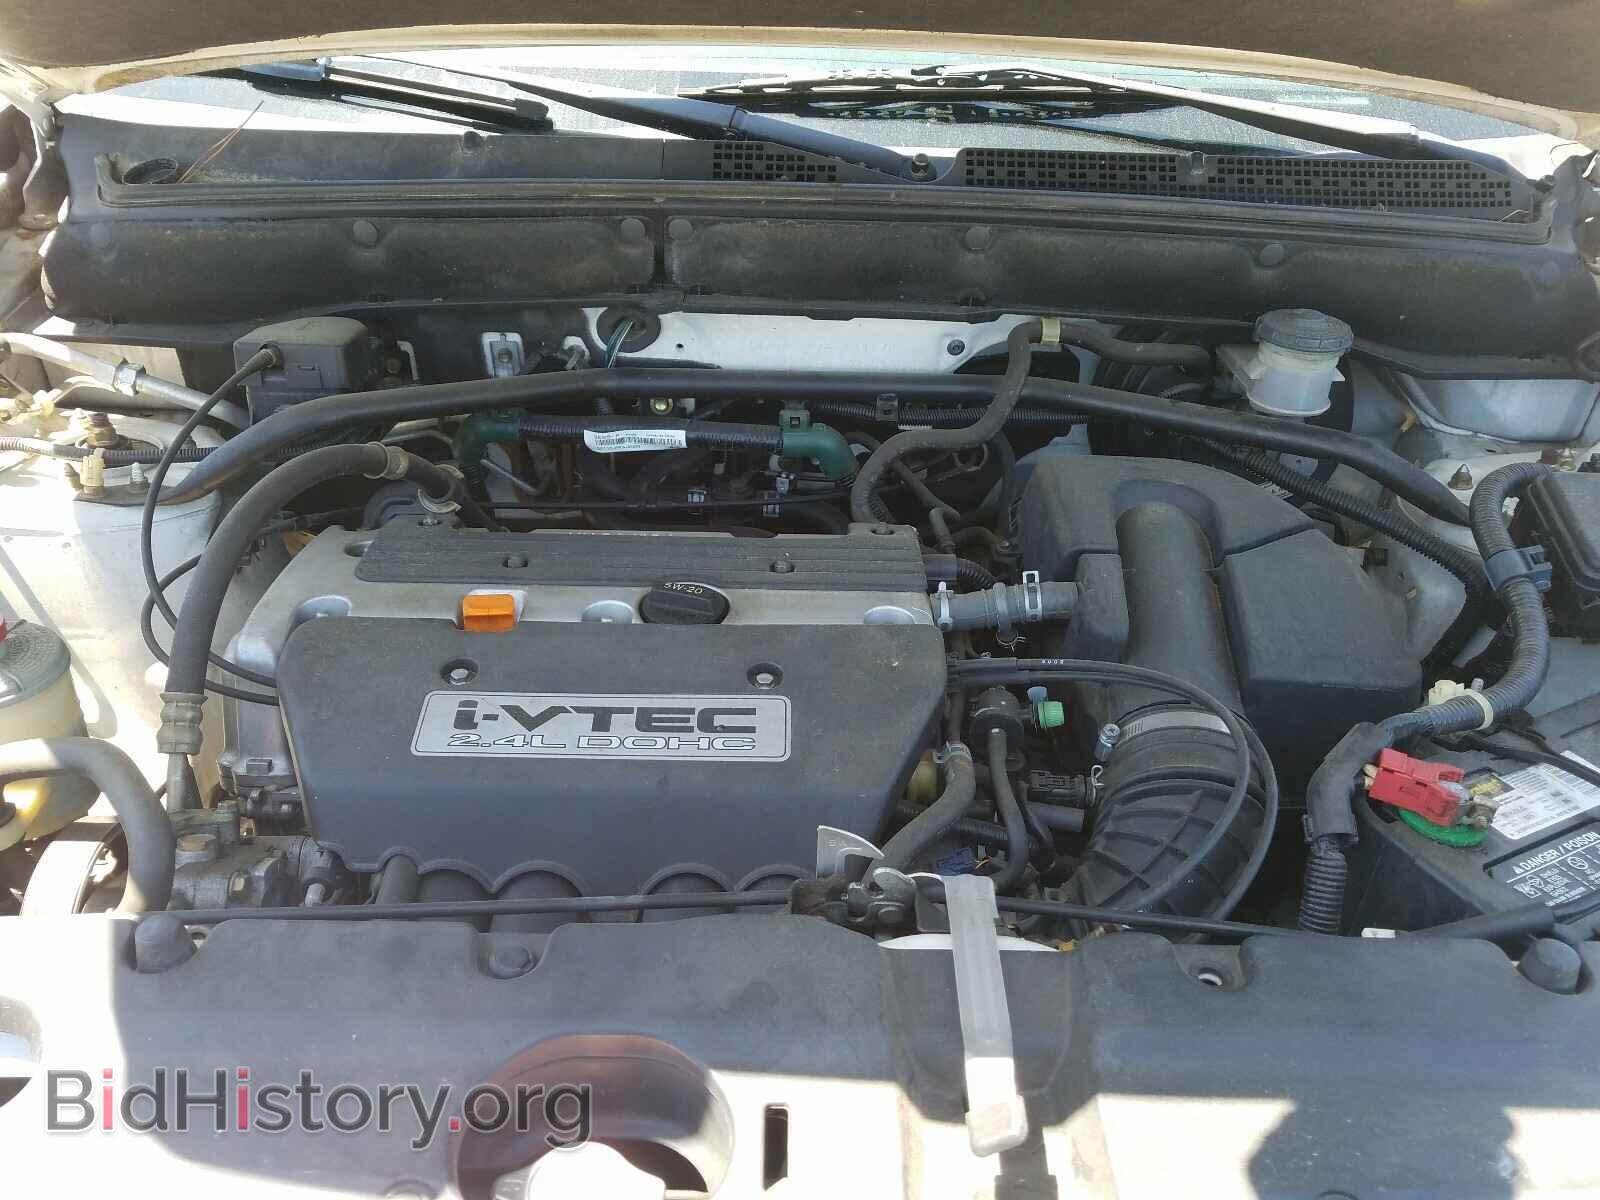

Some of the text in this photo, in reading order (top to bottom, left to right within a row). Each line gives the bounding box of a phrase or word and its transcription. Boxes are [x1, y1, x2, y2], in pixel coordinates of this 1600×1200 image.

[453, 699, 757, 734] i-VTEC
[447, 733, 757, 751] 2.4L DOHC
[1519, 849, 1561, 872] DANGER
